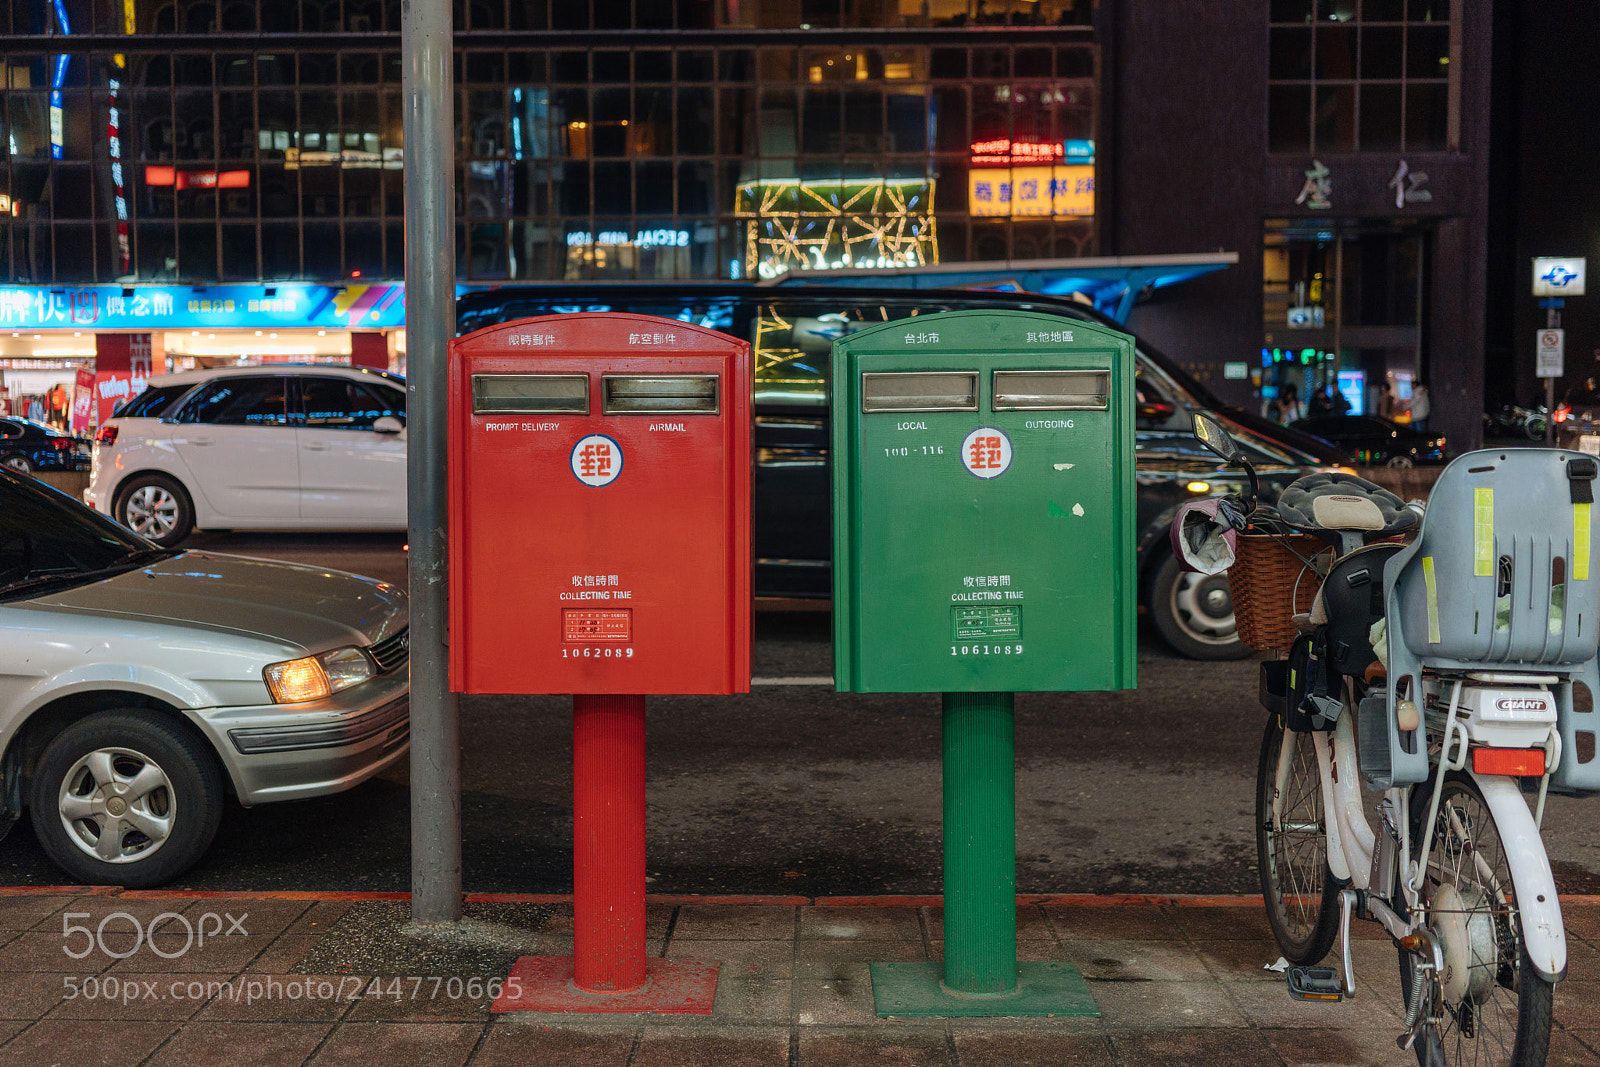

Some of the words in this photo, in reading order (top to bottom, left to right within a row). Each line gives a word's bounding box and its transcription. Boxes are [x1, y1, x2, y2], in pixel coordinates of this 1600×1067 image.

[508, 334, 556, 346] 限時郵件
[629, 333, 676, 345] 航空郵件
[904, 333, 940, 344] 台北市
[1025, 331, 1074, 343] 其他地區
[485, 423, 519, 432] PROMPT
[521, 423, 560, 432] DELIVERY
[649, 423, 687, 432] AIRMAIL
[897, 421, 928, 430] LOCAL
[1025, 419, 1074, 429] OUTGOING
[572, 575, 619, 587] 收信時間
[963, 575, 1011, 587] 收信時間
[560, 591, 610, 600] COLLECTING
[612, 591, 632, 599] TIME
[951, 591, 1002, 601] COLLECTING
[1004, 591, 1024, 600] TIME
[562, 648, 634, 658] 1062089
[951, 645, 1023, 656] 1061089
[1501, 701, 1544, 709] GIANT
